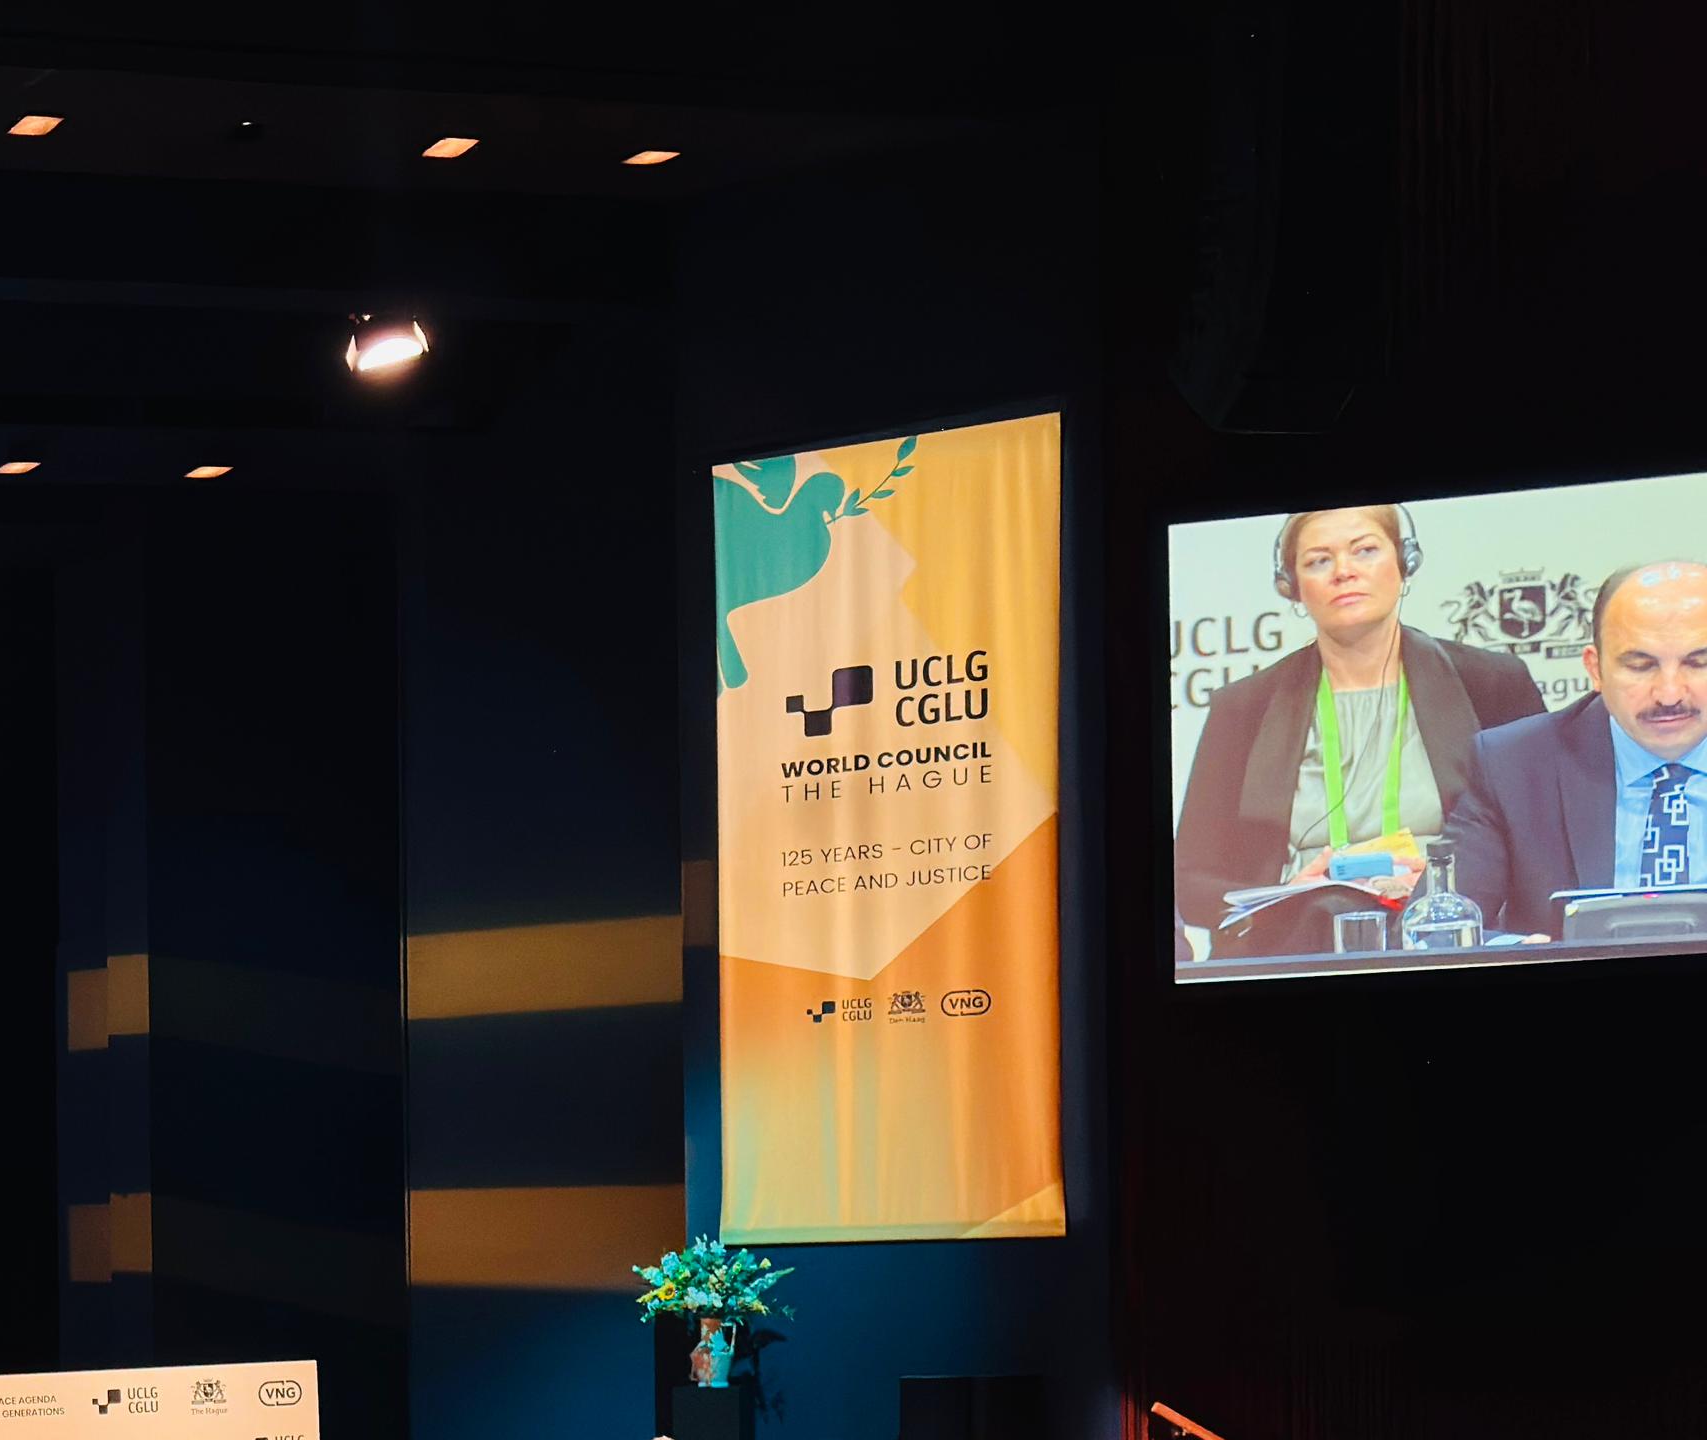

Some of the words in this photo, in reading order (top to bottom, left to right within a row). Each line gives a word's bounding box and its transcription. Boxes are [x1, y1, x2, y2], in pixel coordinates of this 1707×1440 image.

[895, 650, 988, 690] UCLG
[896, 688, 988, 727] CGLU
[781, 754, 870, 778] WORLD
[877, 741, 991, 768] COUNCIL
[782, 779, 841, 803] THE
[869, 765, 992, 794] HAGUE
[781, 849, 812, 867] 125
[821, 844, 882, 863] YEARS
[910, 836, 956, 856] CITY
[966, 833, 992, 850] OF
[783, 877, 846, 896] PEACE
[854, 872, 897, 890] AND
[906, 865, 991, 887] JUSTICE
[842, 998, 872, 1010] UCLG
[948, 996, 983, 1009] VNG
[843, 1010, 872, 1021] CGLU
[128, 1387, 158, 1399] UCLG
[265, 1388, 296, 1399] VNG
[128, 1401, 159, 1414] CGLU
